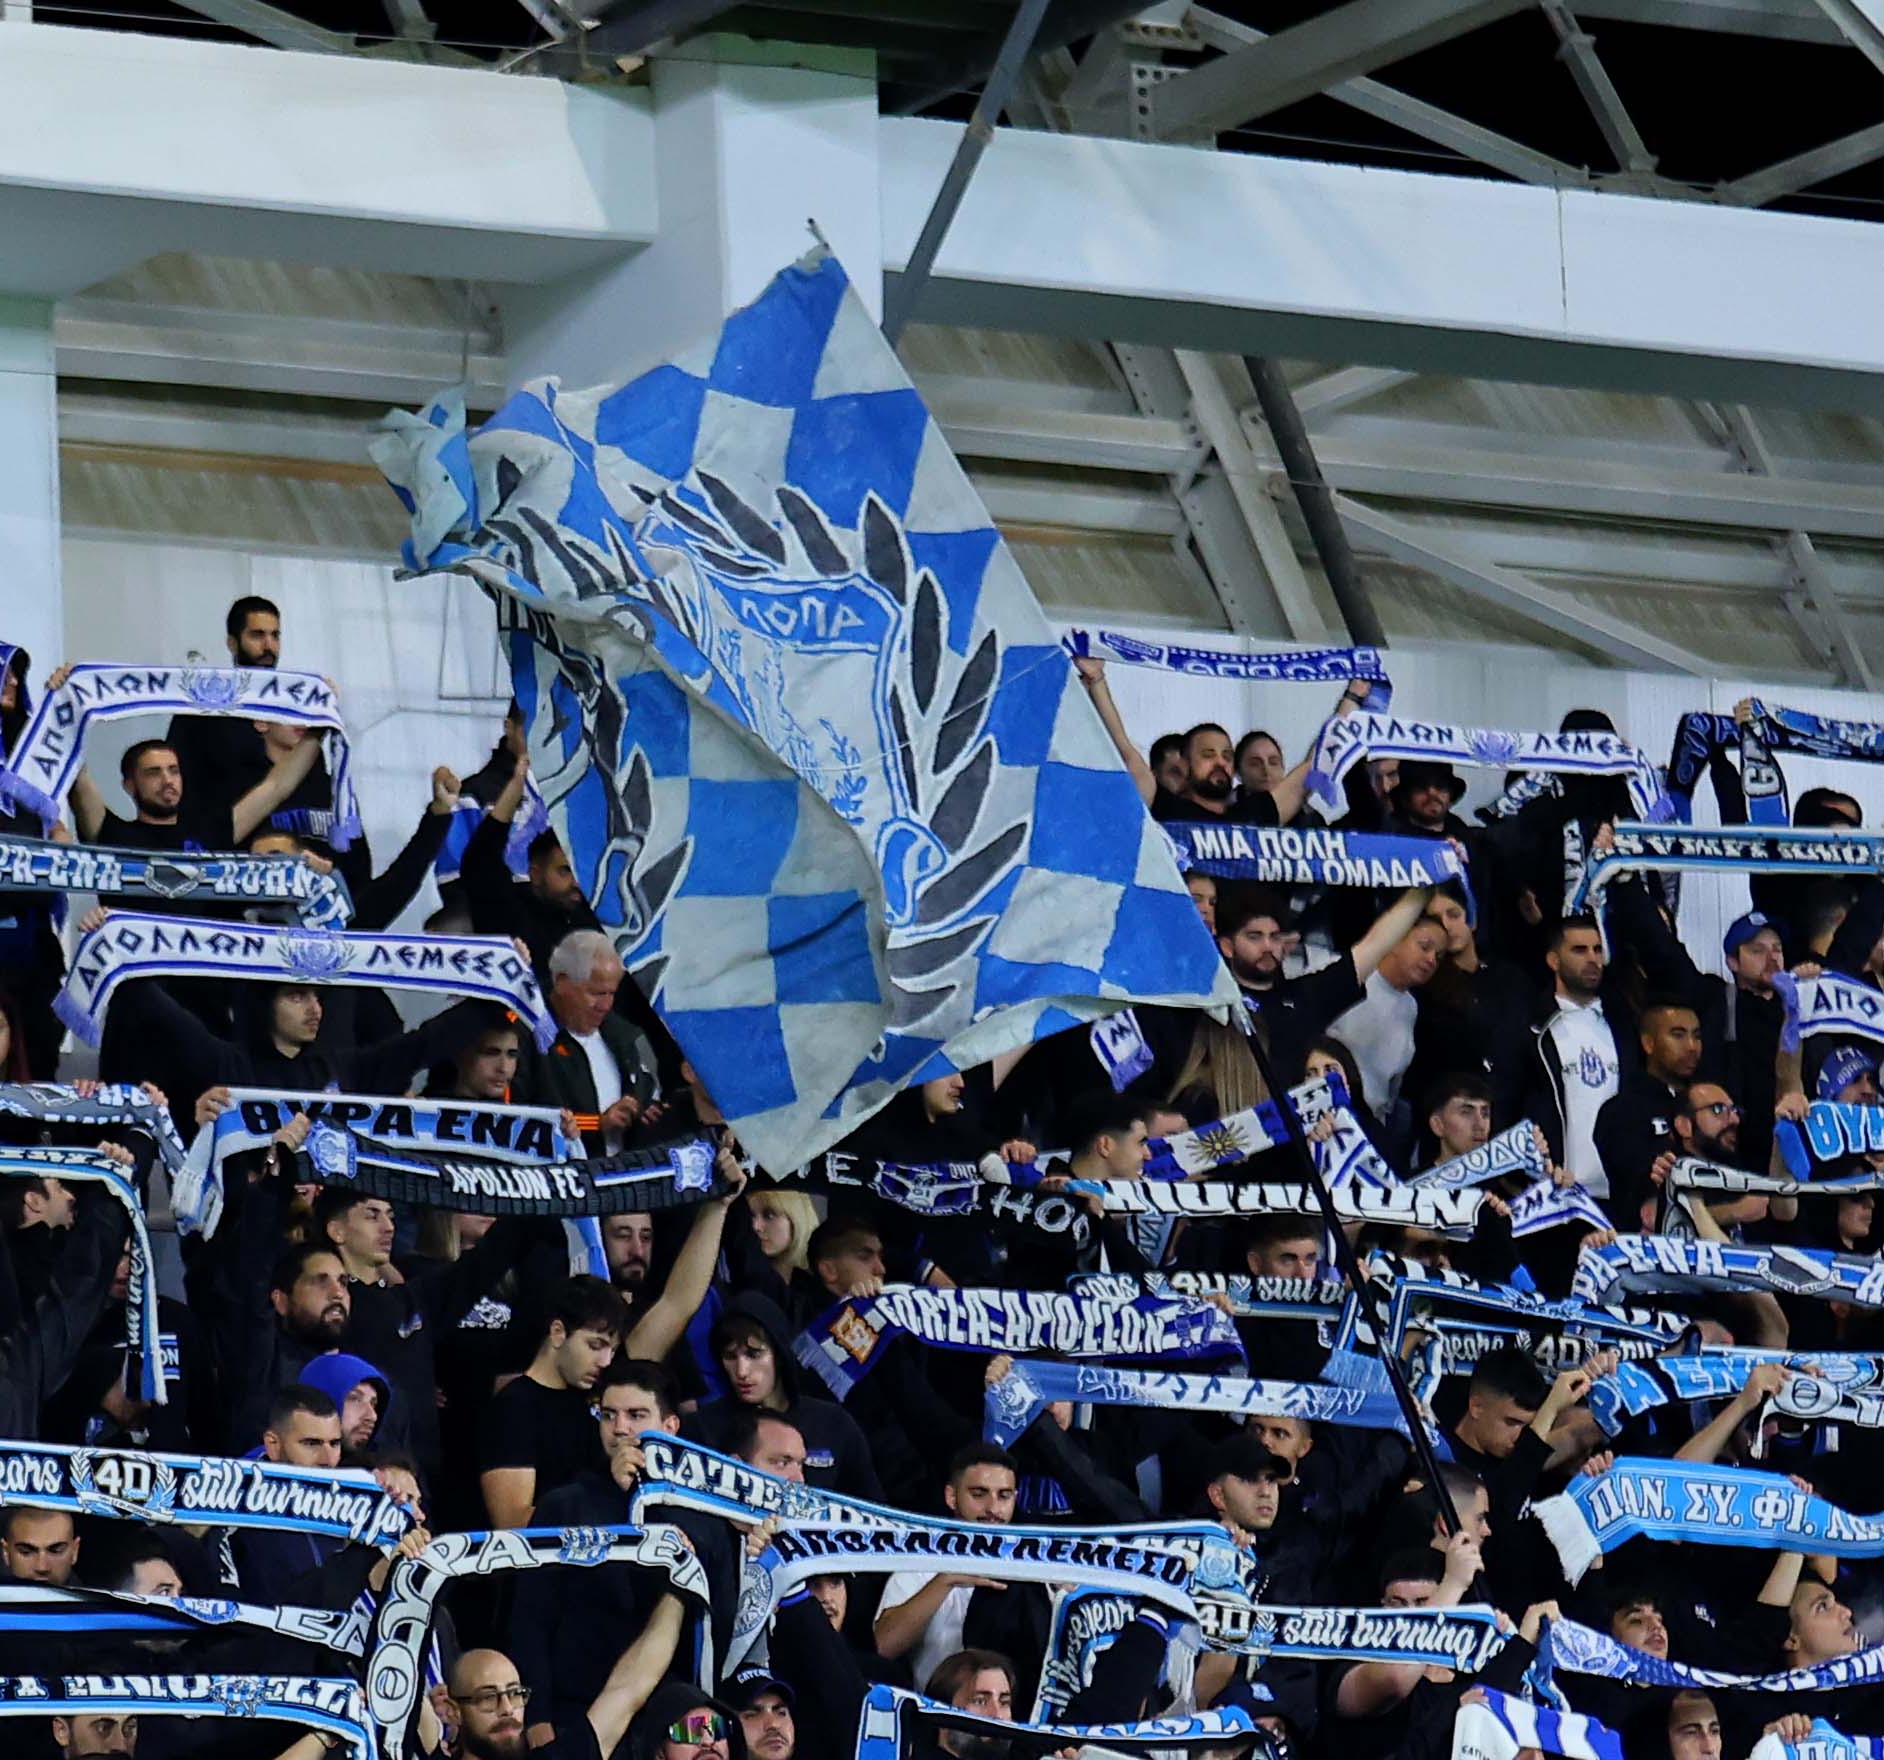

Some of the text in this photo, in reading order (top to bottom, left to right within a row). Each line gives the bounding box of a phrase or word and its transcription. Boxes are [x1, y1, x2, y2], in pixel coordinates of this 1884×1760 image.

[1192, 828, 1346, 863] ΜΙΑ ΠΟΛΗ
[435, 1107, 557, 1160] ΕΝΑ
[443, 1163, 587, 1200] APOLLON FC
[1615, 1235, 1730, 1278] ΕΝΑ
[91, 1454, 160, 1500] 40
[181, 1464, 244, 1508] still
[246, 1464, 370, 1537] burning
[771, 1526, 1004, 1566] ΑΠΟΛΛΩΝ
[1283, 1610, 1350, 1649] still
[1352, 1611, 1473, 1660] burning
